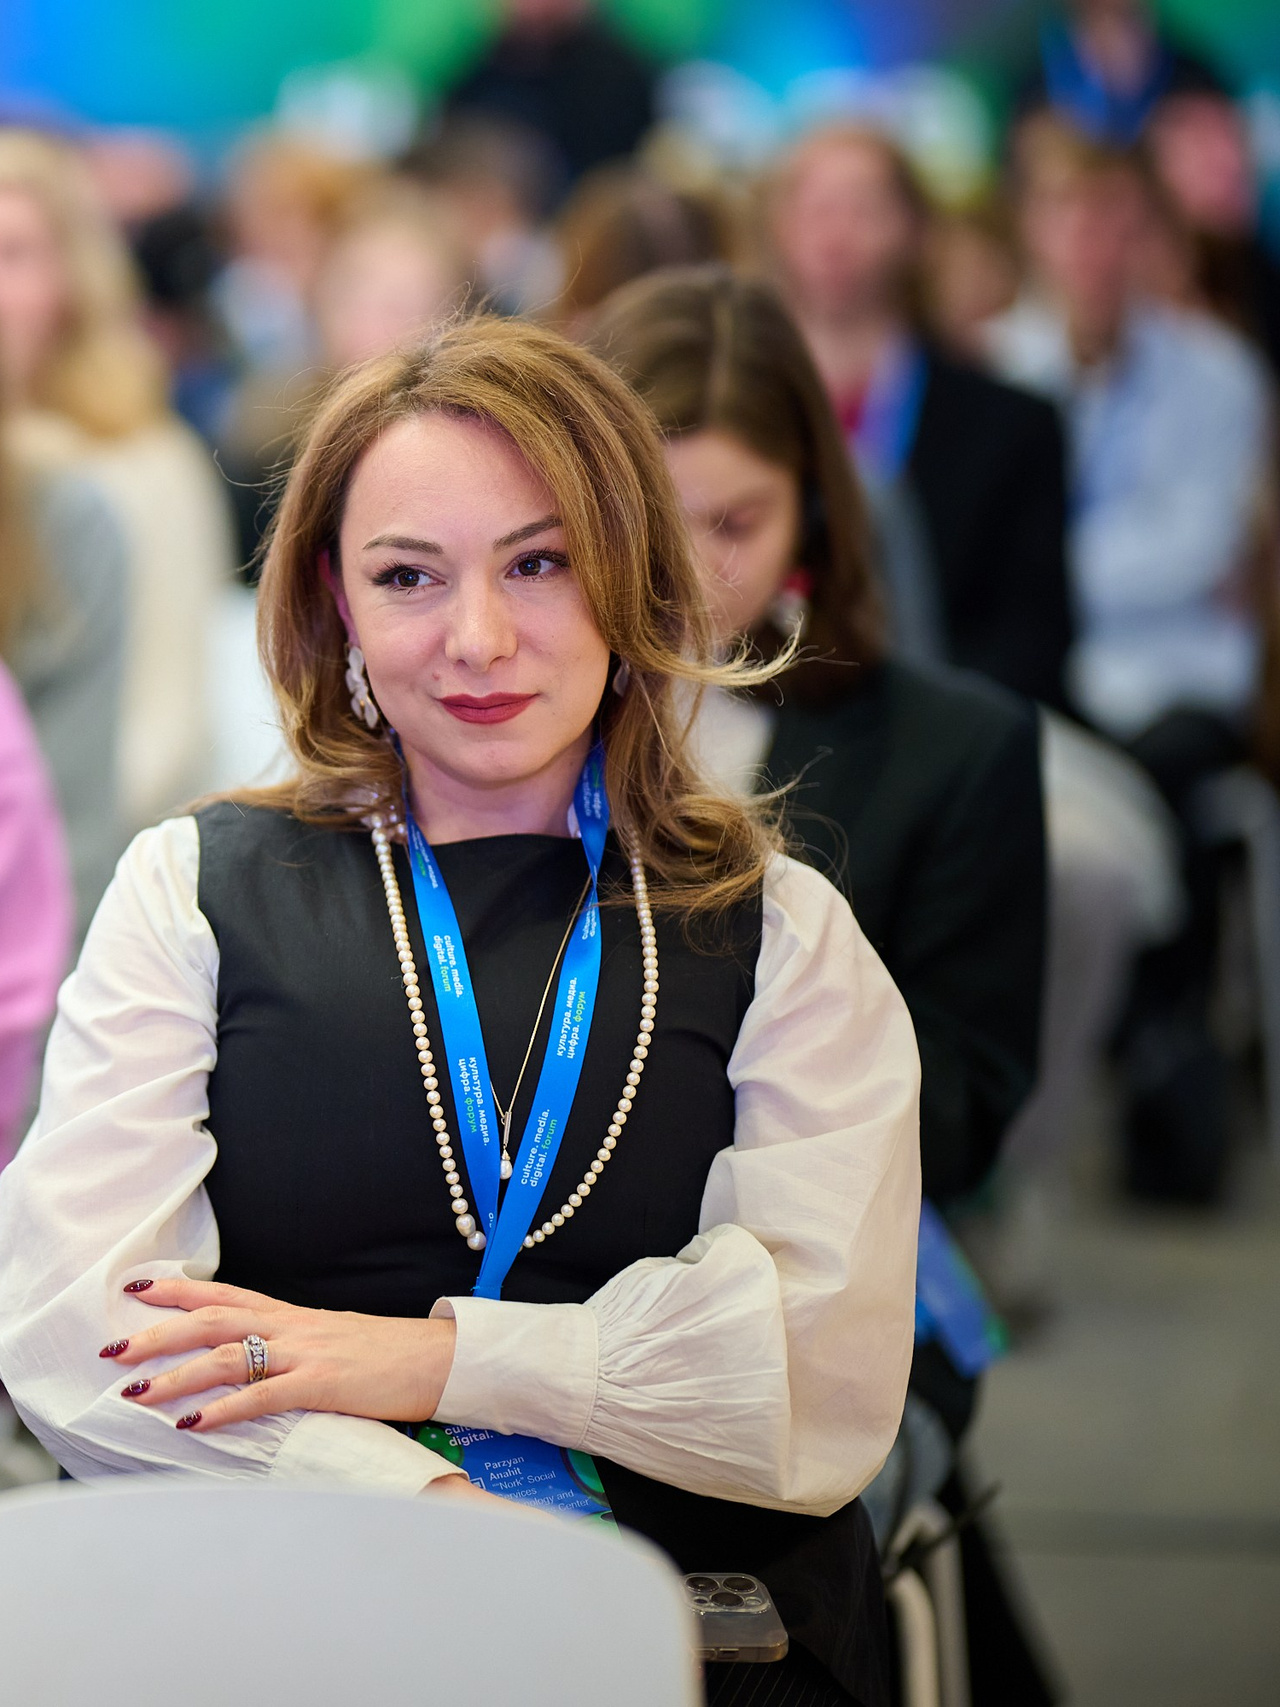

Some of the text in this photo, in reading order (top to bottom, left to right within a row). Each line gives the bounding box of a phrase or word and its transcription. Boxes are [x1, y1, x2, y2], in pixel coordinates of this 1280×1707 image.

[433, 935, 452, 992] digital. forum
[443, 934, 463, 998] culture. media.
[557, 977, 578, 1057] культура. медиа.
[567, 991, 586, 1059] цифра. форум
[458, 1058, 477, 1133] цифра. форум
[469, 1057, 490, 1146] культура. медиа.
[521, 1108, 550, 1185] culture. media.
[529, 1119, 557, 1187] digital. forum
[449, 1431, 494, 1447] digital.
[484, 1456, 525, 1471] Parzyan
[489, 1467, 523, 1482] Anahit
[528, 1470, 557, 1485] Social
[556, 1489, 575, 1502] and
